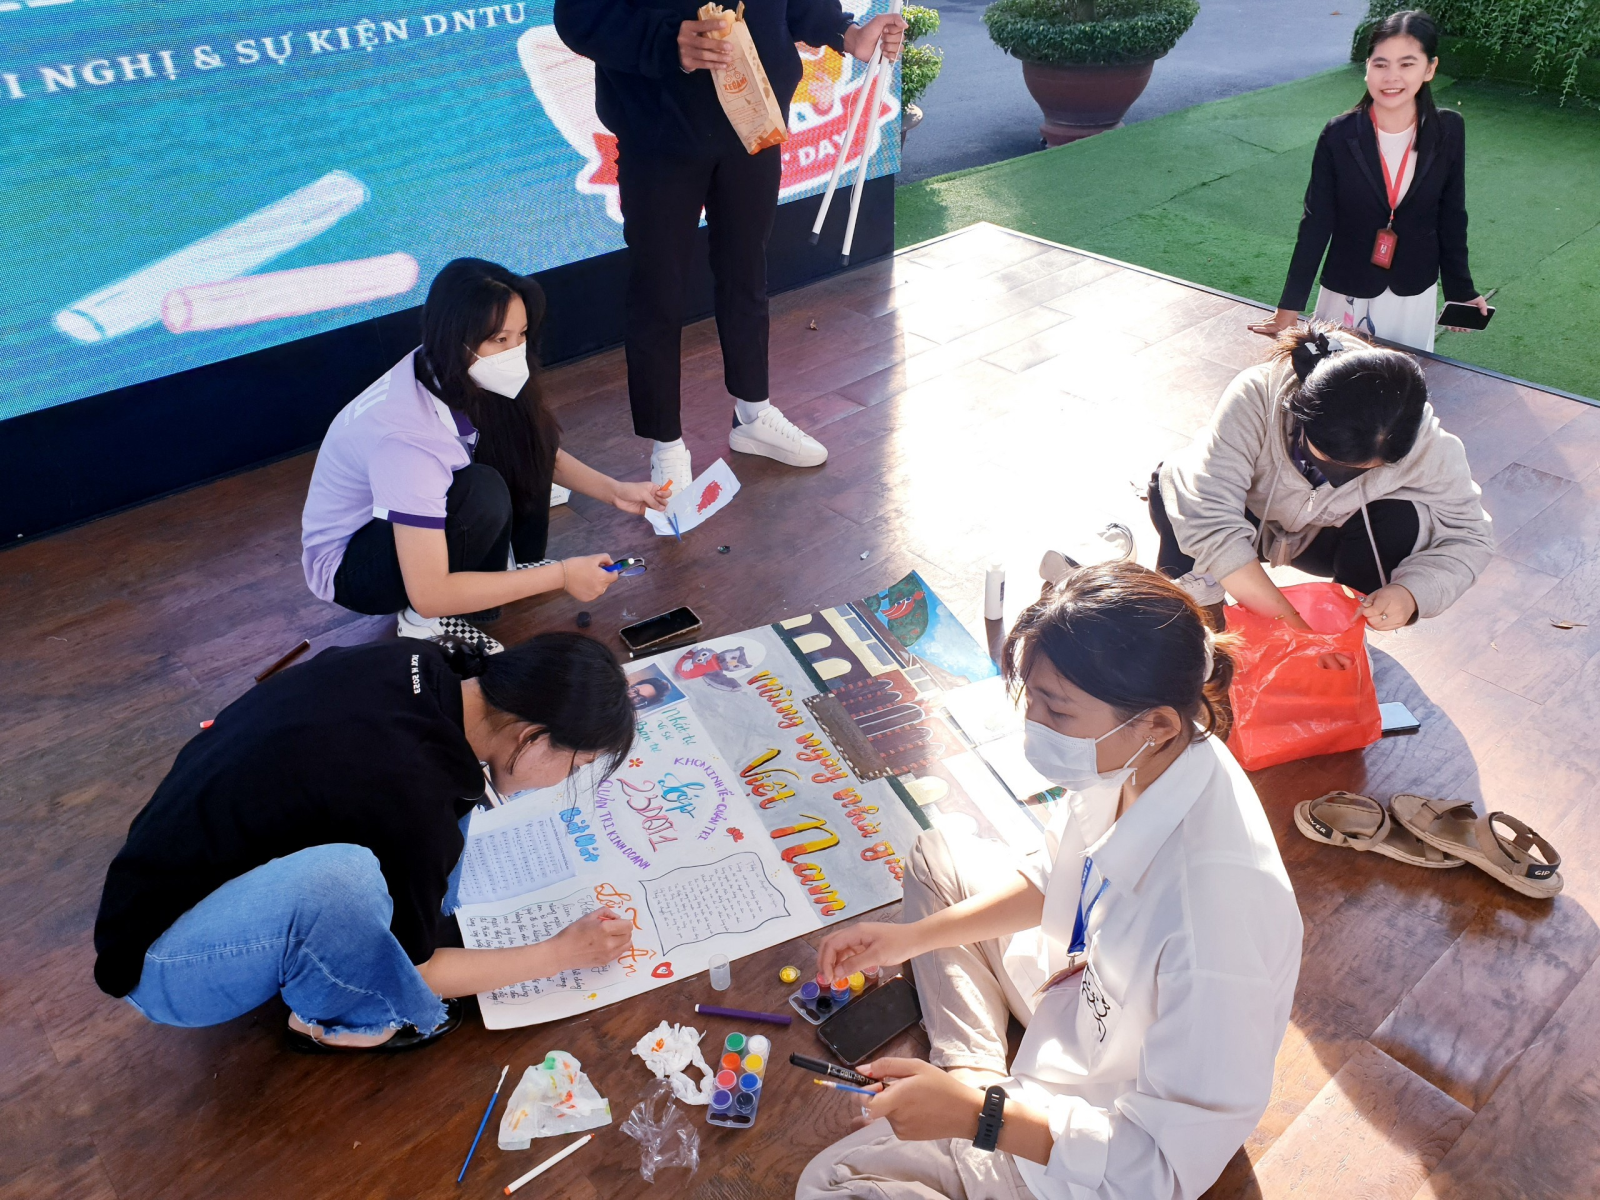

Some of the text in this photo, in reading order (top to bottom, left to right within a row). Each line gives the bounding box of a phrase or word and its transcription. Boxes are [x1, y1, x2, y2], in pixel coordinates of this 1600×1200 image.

[39, 50, 181, 92] NGHỊ
[193, 44, 226, 70] &
[235, 31, 293, 66] SỰ
[307, 18, 410, 54] KIỆN
[422, 2, 526, 37] DNTU
[657, 772, 706, 819] Lớp
[673, 757, 706, 769] KHOA
[703, 765, 725, 789] KINH
[739, 747, 847, 917] Việt Nam
[795, 732, 849, 784] ngày
[832, 786, 882, 838] nhà
[861, 841, 905, 889] gia
[606, 830, 628, 850] KINH
[622, 847, 651, 870] DOANH
